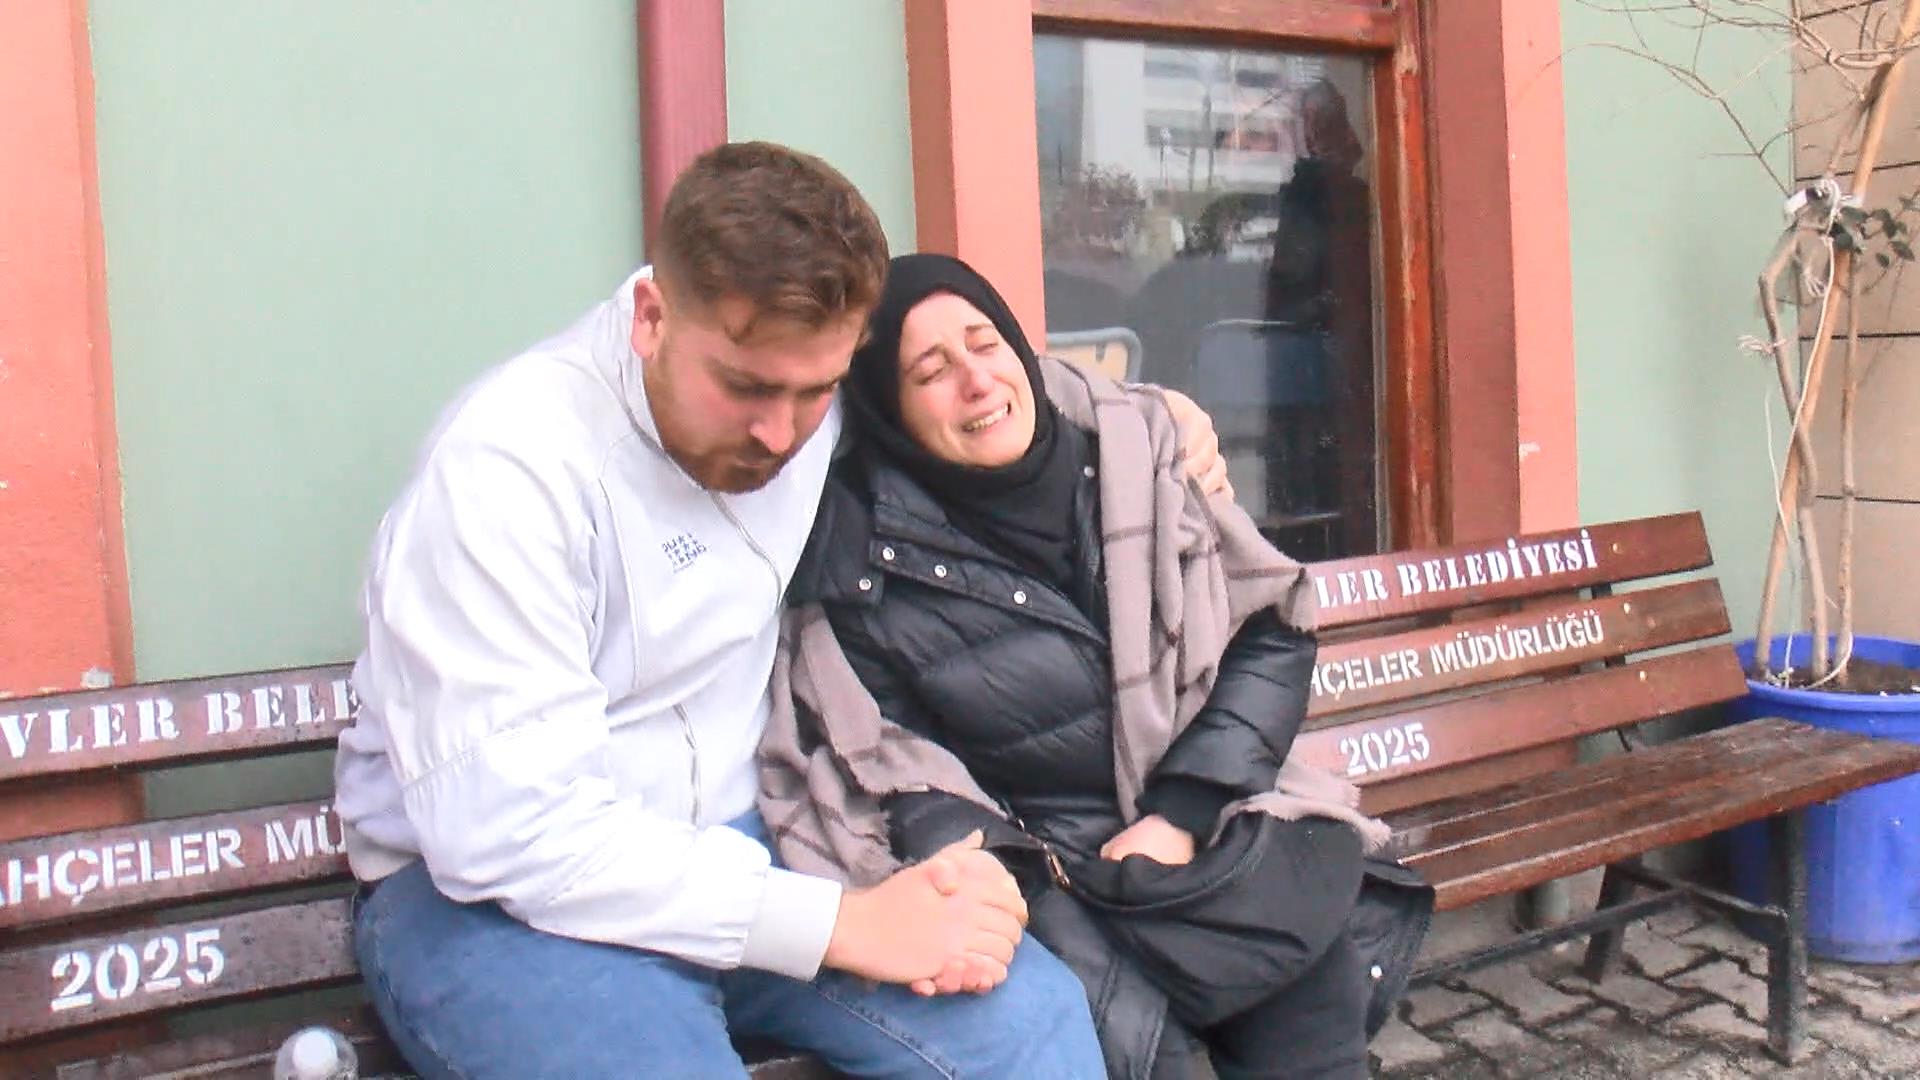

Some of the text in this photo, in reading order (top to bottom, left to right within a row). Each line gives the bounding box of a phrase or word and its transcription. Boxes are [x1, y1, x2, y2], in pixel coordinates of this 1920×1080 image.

[1315, 529, 1598, 608] LER BELEDİYESİ
[1429, 608, 1605, 674] MÜDÜRLÜĞÜ
[0, 698, 180, 758] VLER
[1340, 722, 1430, 777] 2025
[0, 828, 245, 907] HÇELER
[50, 929, 225, 1012] 2025
